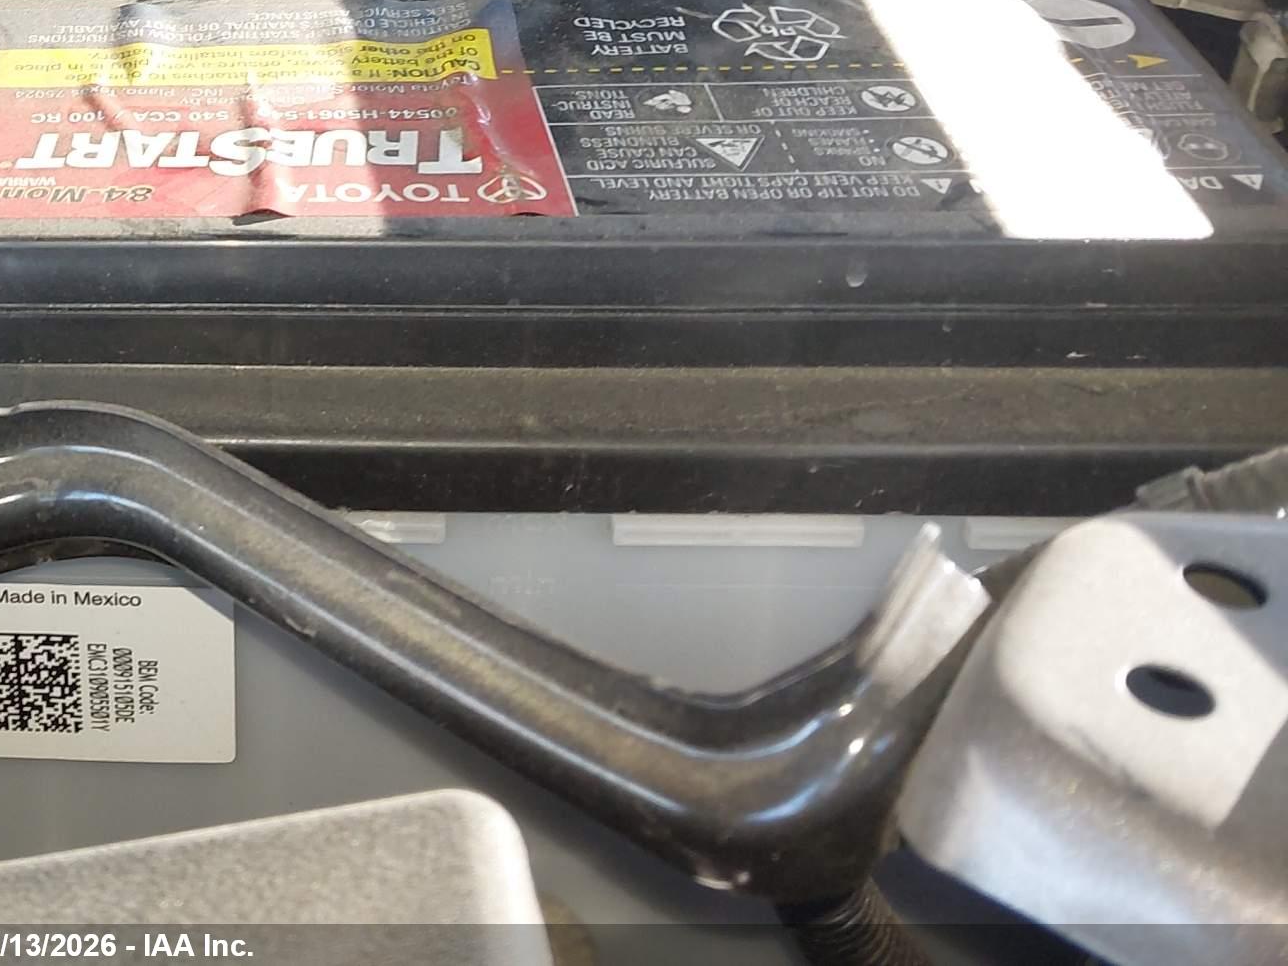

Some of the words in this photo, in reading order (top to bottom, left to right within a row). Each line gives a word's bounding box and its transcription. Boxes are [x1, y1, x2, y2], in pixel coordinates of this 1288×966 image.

[179, 23, 194, 32] IF
[198, 22, 220, 31] OR
[379, 16, 442, 29] VEHICLE
[573, 16, 686, 30] RECYCLED
[26, 27, 144, 44] INSTRUCTIONS
[451, 34, 476, 43] on
[582, 30, 613, 42] BE
[619, 30, 686, 43] MUST
[358, 45, 411, 57] other
[590, 43, 688, 56] BATTERY
[13, 62, 62, 72] place
[351, 55, 419, 67] battery
[67, 63, 84, 72] in
[386, 58, 481, 78] CAUTION:
[148, 72, 166, 80] to
[350, 84, 404, 94] Motor
[551, 99, 631, 111] INSTRUC-
[769, 96, 792, 107] OF
[796, 95, 851, 106] REACH
[132, 110, 181, 122] CCA
[189, 110, 228, 122] 540
[590, 108, 635, 119] READ
[751, 106, 774, 117] OF
[778, 105, 811, 116] OUT
[815, 104, 858, 116] KEEP
[30, 112, 62, 124] RC
[68, 110, 105, 124] 100
[670, 124, 733, 135] SEVERE
[737, 124, 761, 135] OR
[579, 136, 680, 148] BLINDNESS
[595, 148, 655, 159] CAUSE
[658, 147, 697, 158] CAN
[586, 160, 628, 171] ACID
[631, 158, 716, 169] SULFURIC
[858, 155, 886, 167] NO
[589, 178, 648, 189] LEVEL.
[653, 177, 694, 188] AND
[700, 176, 754, 187] TIGHT
[758, 175, 808, 187] CAPS
[814, 174, 861, 186] VENT
[866, 173, 913, 185] KEEP
[277, 178, 470, 203] TOYOTA
[733, 188, 783, 200] OPEN
[786, 187, 813, 200] OR
[817, 187, 848, 199] TIP
[851, 186, 888, 198] NOT
[893, 185, 920, 197] DO
[51, 590, 67, 605] in
[73, 591, 142, 607] Mexico
[138, 660, 158, 682] BEM
[138, 684, 160, 715] Code:
